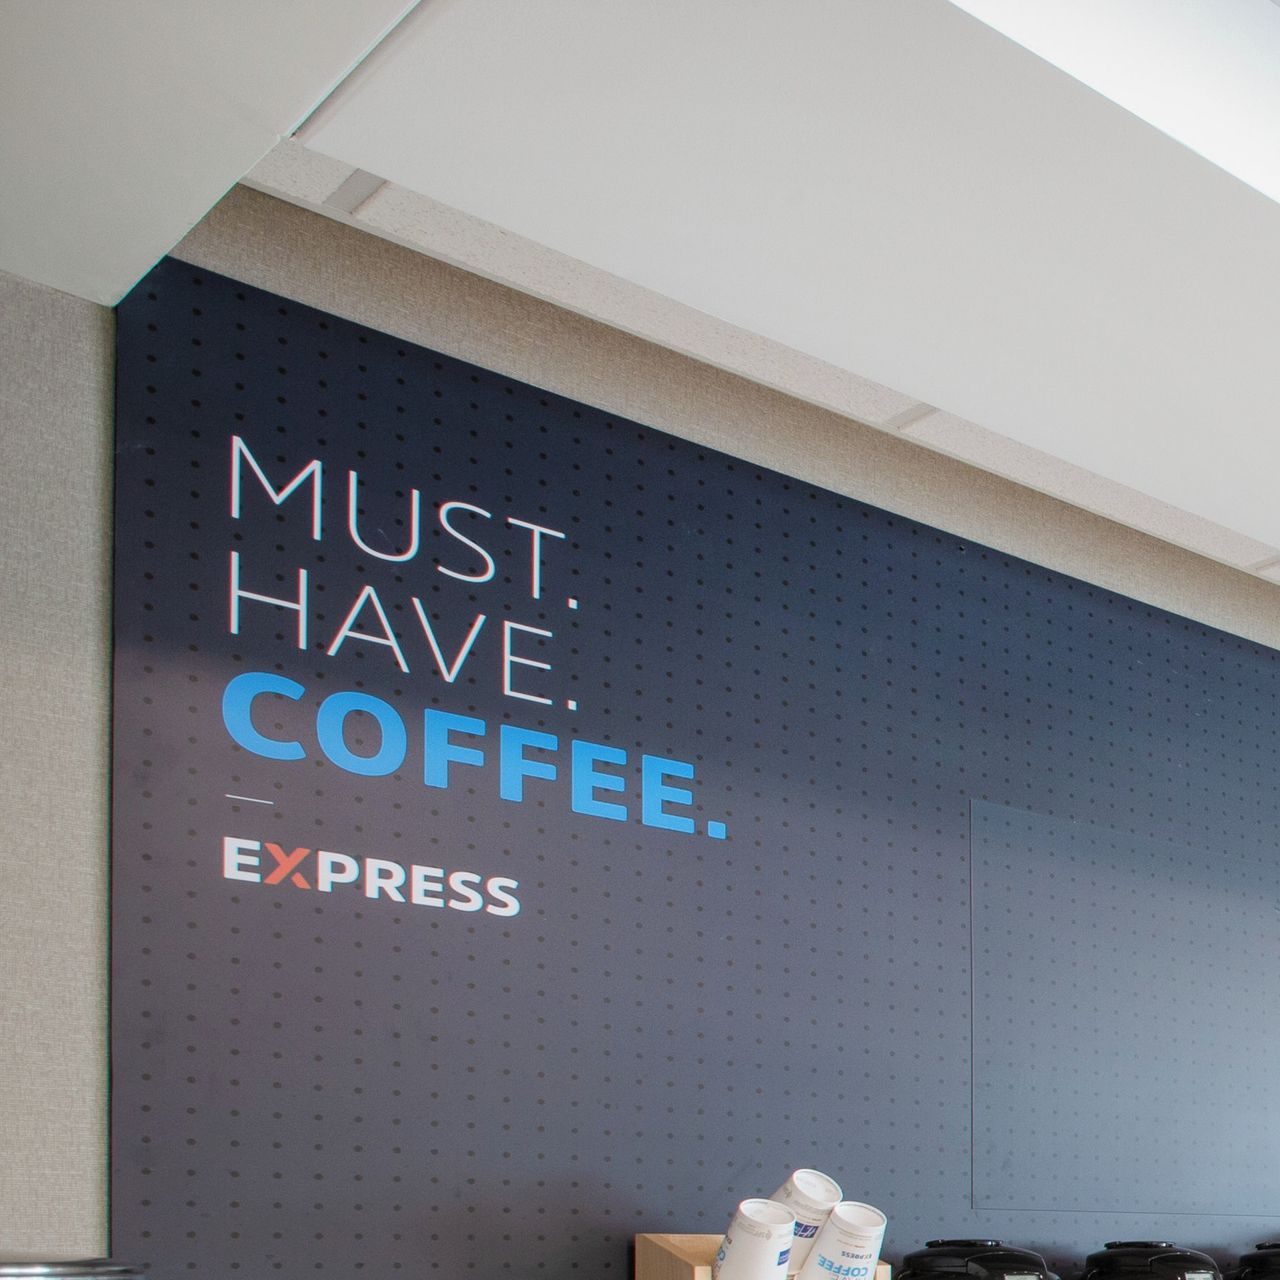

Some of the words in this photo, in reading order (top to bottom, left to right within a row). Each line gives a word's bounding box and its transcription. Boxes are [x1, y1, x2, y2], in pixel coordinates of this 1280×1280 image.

[230, 434, 579, 610] MUST.
[229, 551, 578, 711] HAVE.
[221, 671, 727, 840] COFFEE.
[223, 836, 522, 917] EXPRESS
[818, 1254, 868, 1278] COFFEE.
[841, 1250, 872, 1260] EXPRESS
